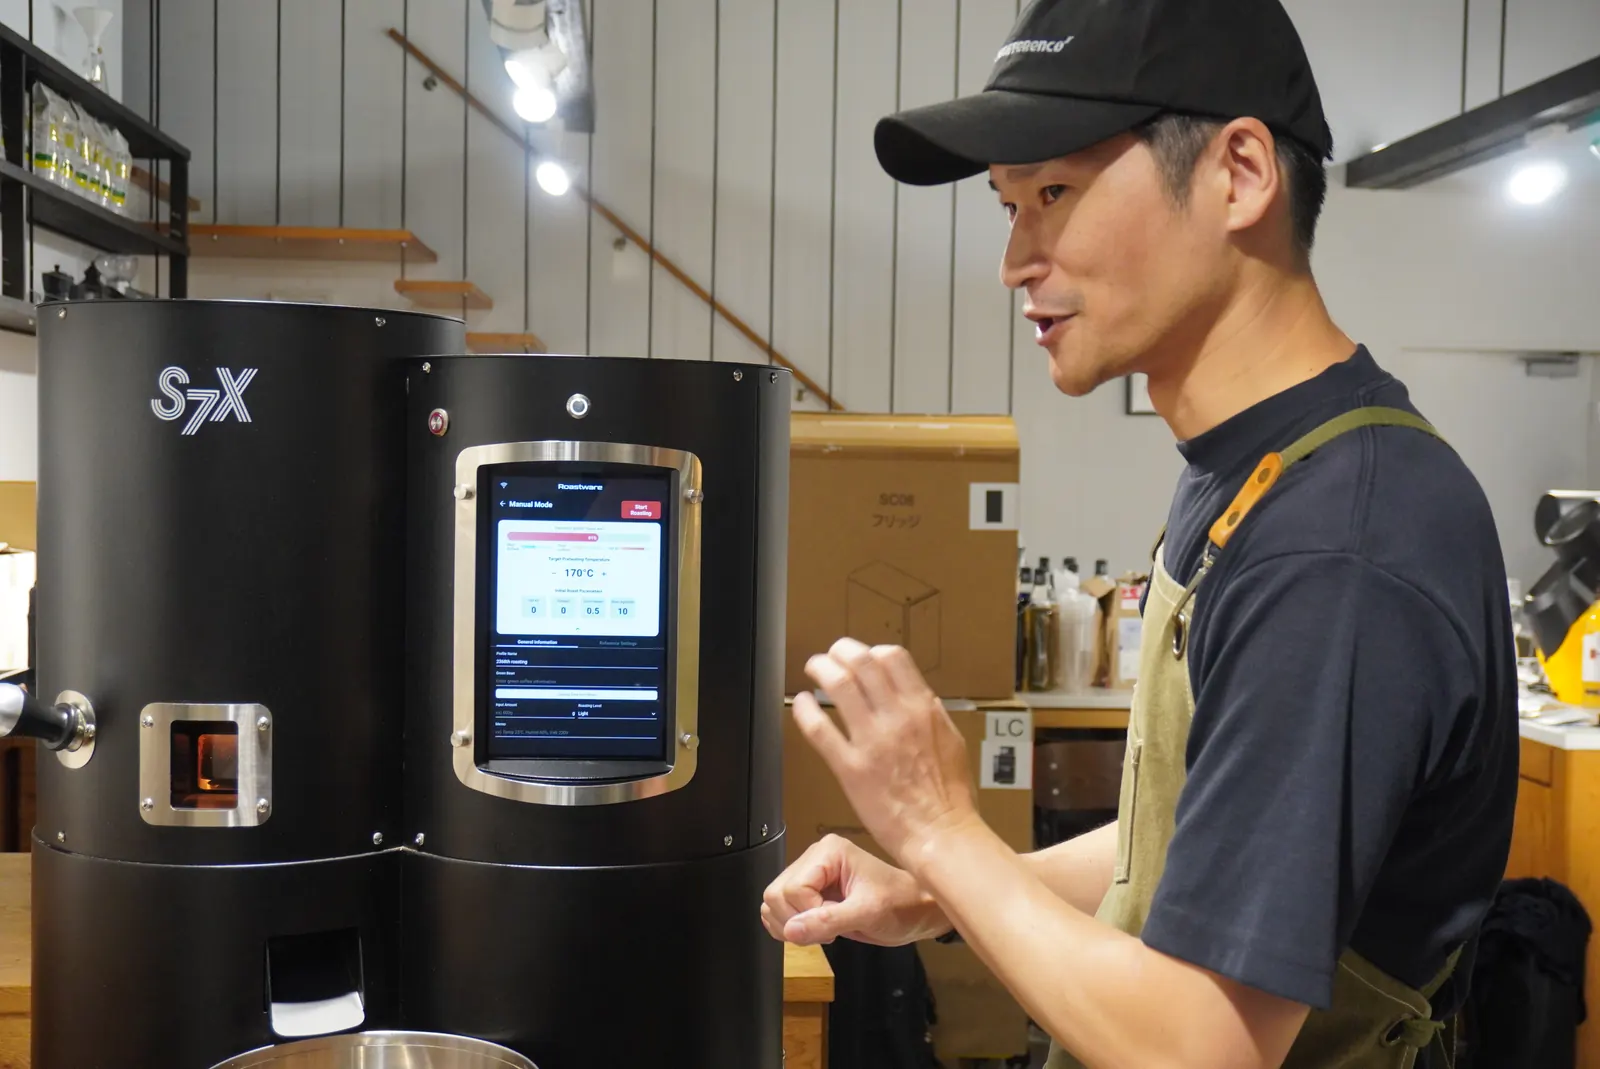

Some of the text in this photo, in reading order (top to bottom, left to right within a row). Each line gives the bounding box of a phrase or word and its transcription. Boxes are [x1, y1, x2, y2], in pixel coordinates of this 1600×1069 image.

[151, 366, 258, 435] S7X
[558, 483, 603, 491] Roastware
[534, 501, 553, 509] Mode
[565, 568, 594, 577] 170°C
[586, 607, 600, 615] 0.5
[995, 719, 1024, 737] LC
